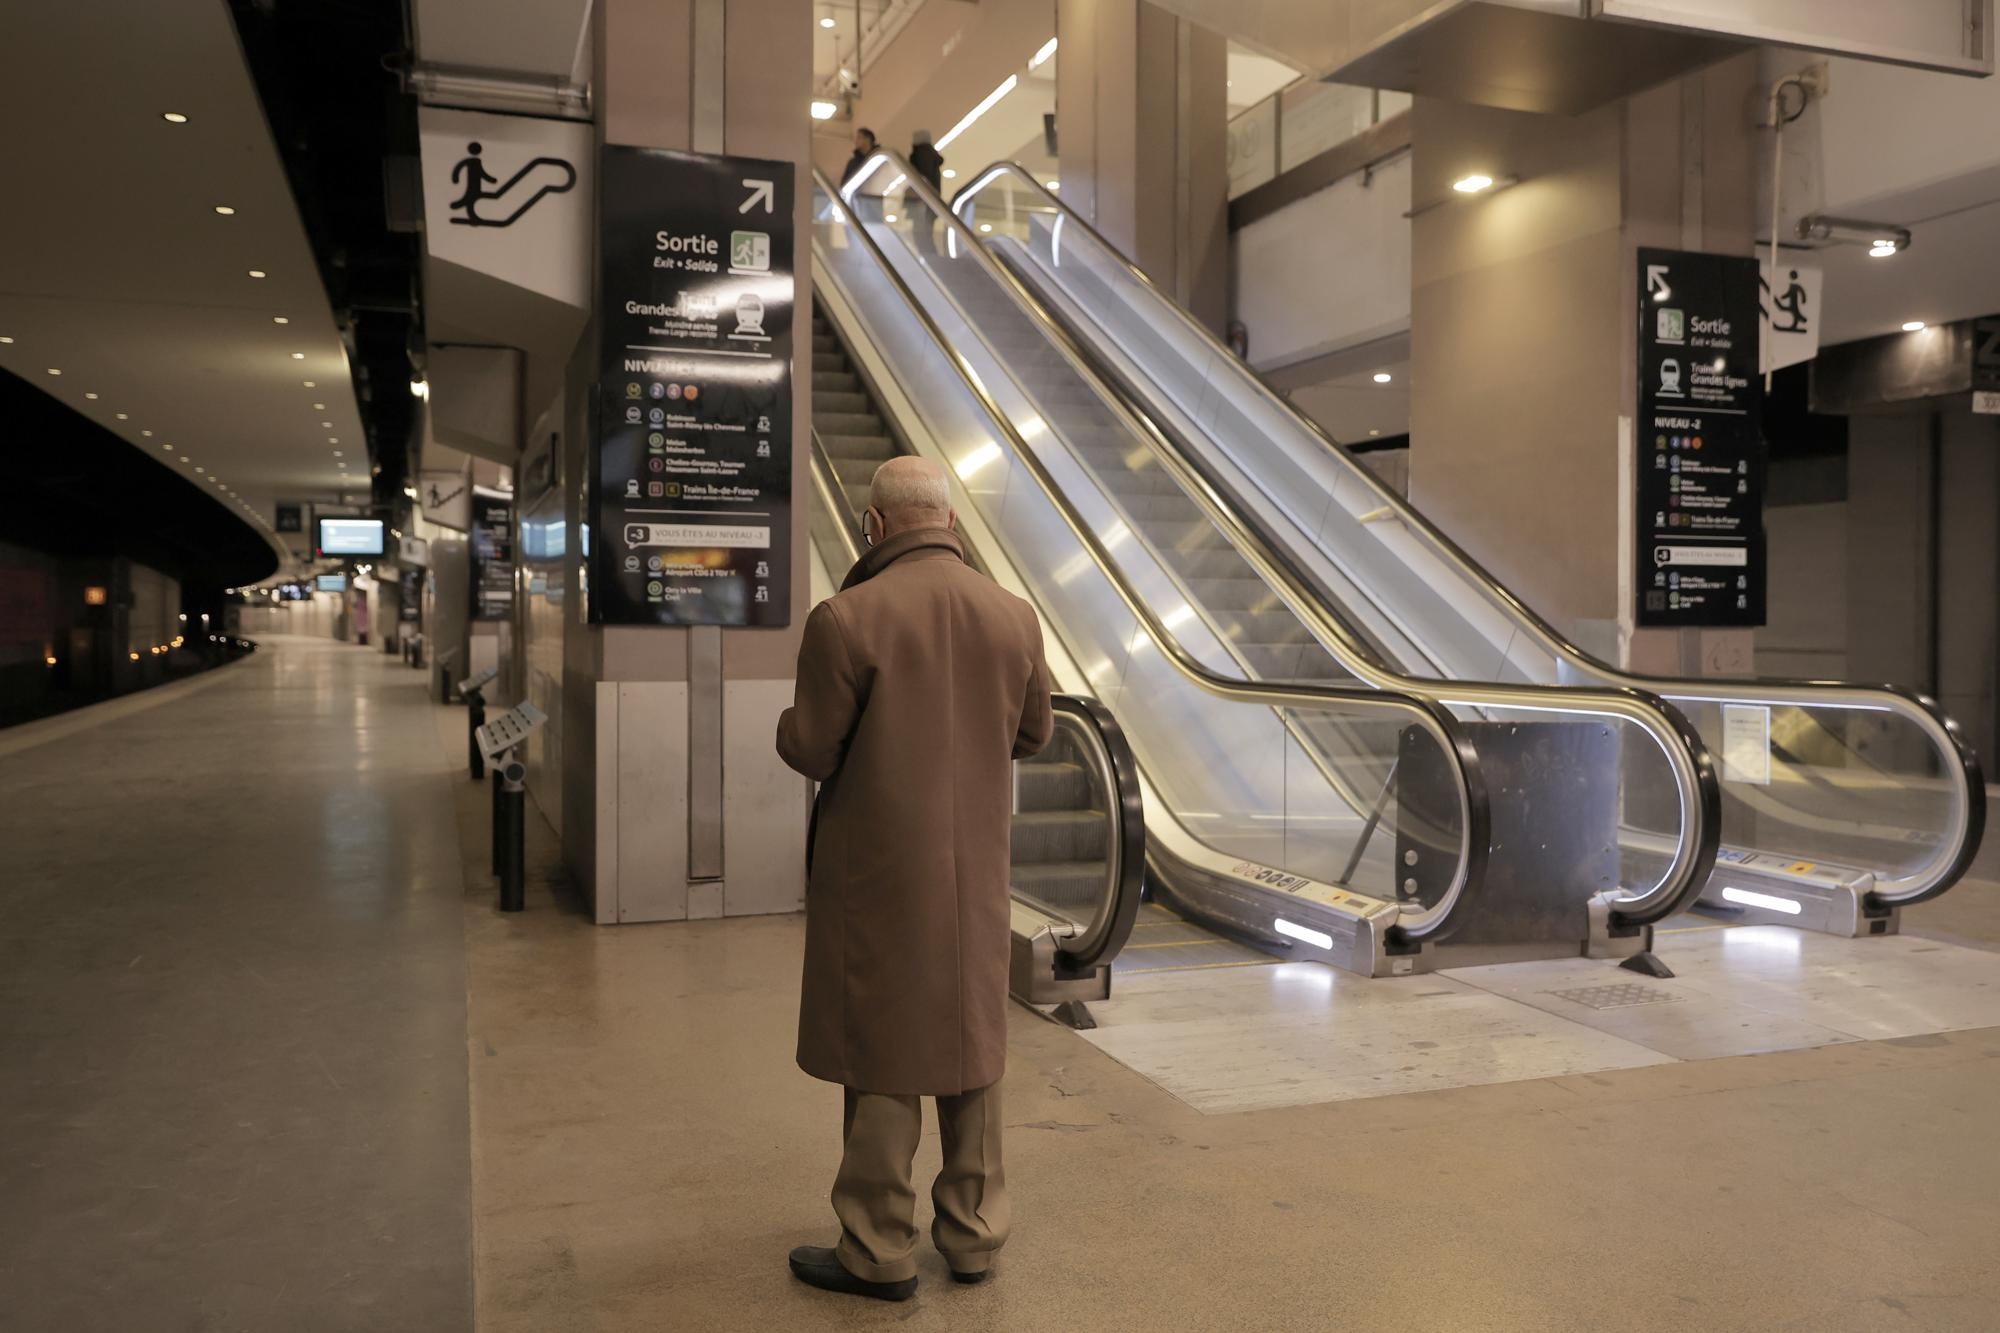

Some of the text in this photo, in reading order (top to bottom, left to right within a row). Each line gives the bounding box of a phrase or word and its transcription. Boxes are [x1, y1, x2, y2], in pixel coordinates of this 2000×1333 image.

[656, 231, 718, 254] Sortie
[654, 256, 718, 272] Exit Salida
[626, 300, 680, 316] Grandes
[1691, 316, 1730, 334] Sortie
[758, 420, 770, 431] 42
[1654, 416, 1690, 429] NIVEAU
[682, 484, 707, 494] Trains
[630, 528, 644, 540] -3
[654, 529, 680, 537] VOUS
[682, 528, 702, 538] ÊTES
[705, 530, 718, 538] AU
[720, 530, 752, 540] NIVEAU
[756, 590, 768, 601] 41
